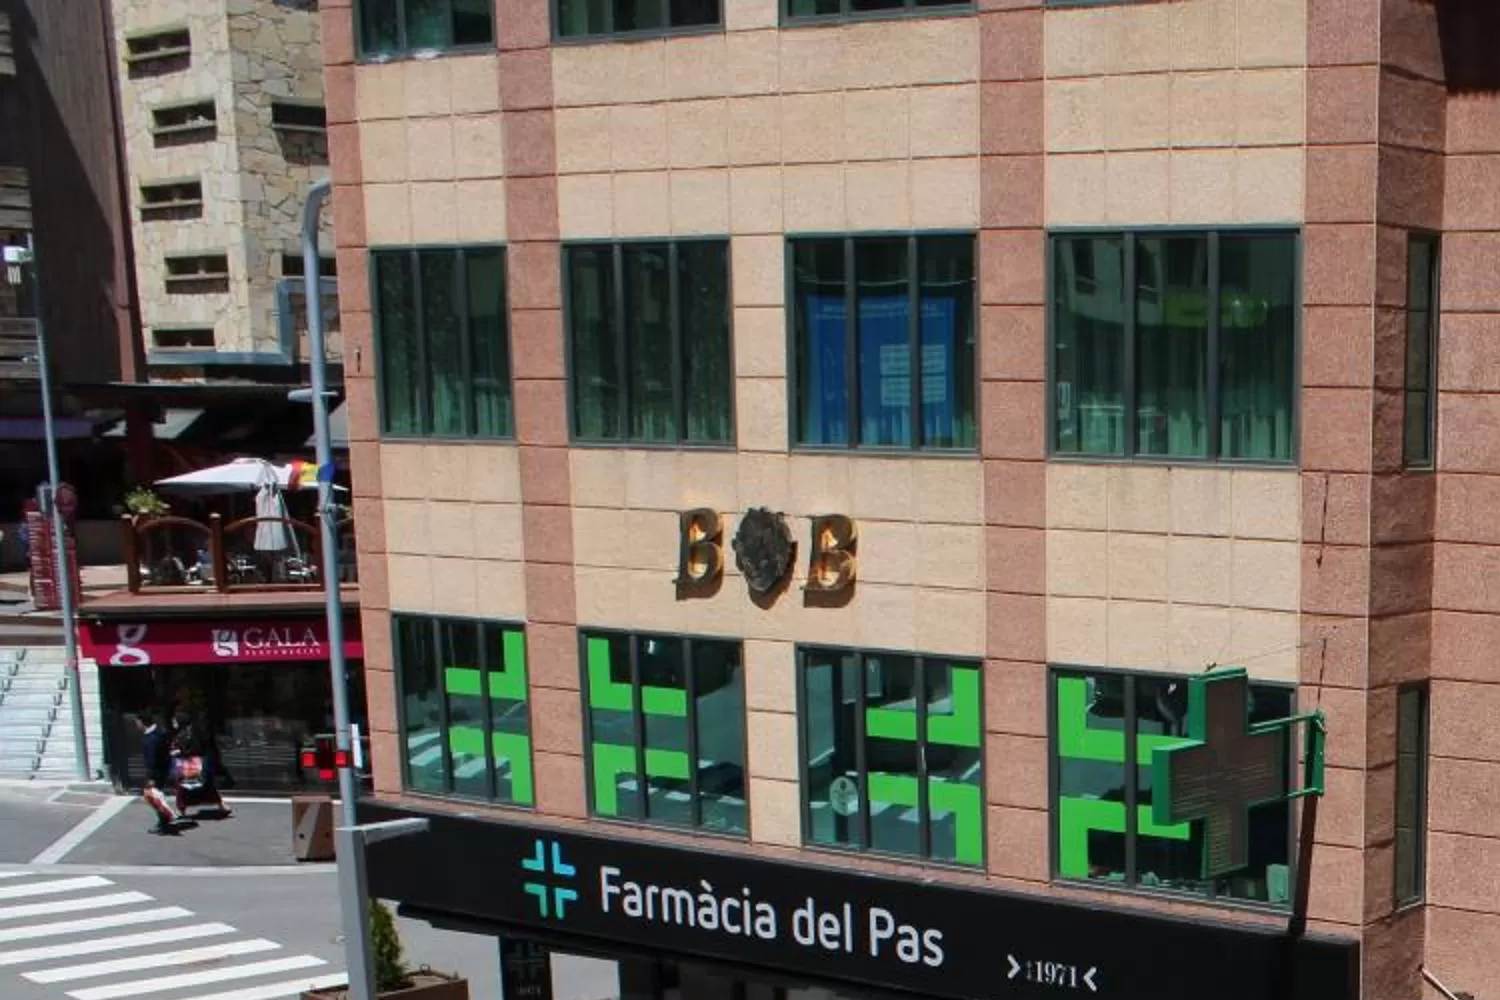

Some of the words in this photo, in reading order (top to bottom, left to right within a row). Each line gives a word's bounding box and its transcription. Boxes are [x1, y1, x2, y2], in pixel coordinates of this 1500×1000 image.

[673, 508, 721, 590] B
[801, 514, 856, 596] B
[243, 627, 321, 648] GALA
[600, 865, 777, 939] Farmàcia
[792, 897, 853, 953] del
[868, 907, 945, 967] Pas
[1035, 960, 1078, 988] 1971
